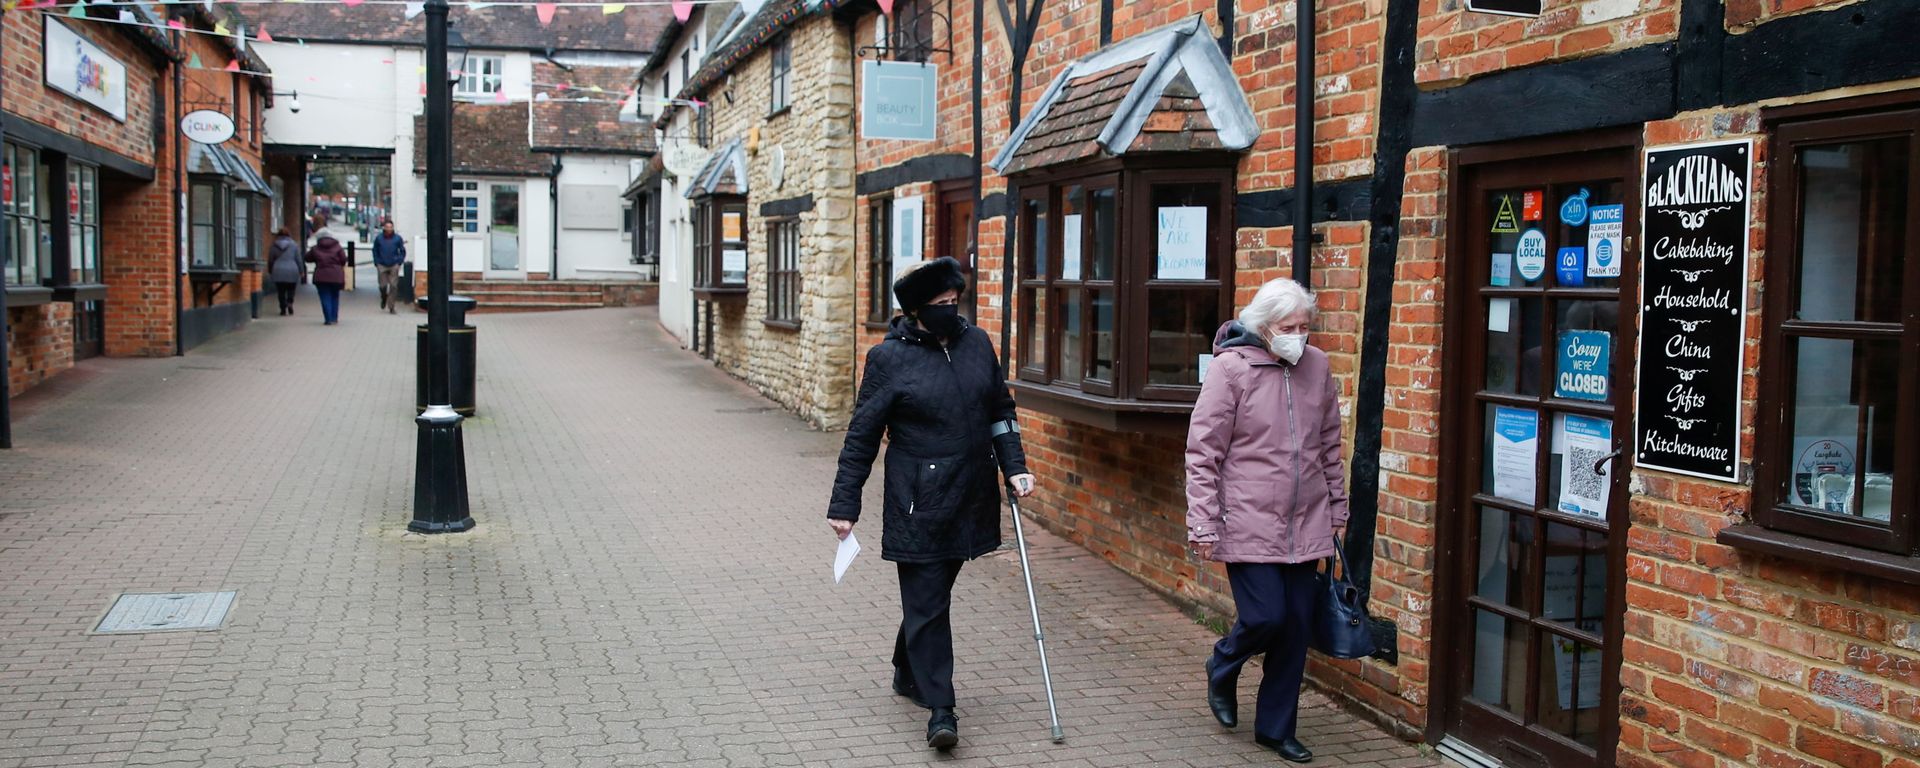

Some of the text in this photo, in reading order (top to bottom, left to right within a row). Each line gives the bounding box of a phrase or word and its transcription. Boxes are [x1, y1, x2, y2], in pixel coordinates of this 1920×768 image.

[876, 103, 916, 114] BEAUTY
[1648, 155, 1744, 208] BLACKHAMS
[1160, 210, 1185, 229] WE
[1592, 208, 1620, 221] NOTICE
[1166, 230, 1192, 245] ARE
[1590, 224, 1606, 232] PLEASE
[1524, 238, 1541, 247] BUY
[1653, 236, 1734, 265] Cakebaking
[1519, 248, 1545, 257] LOCAL
[1588, 267, 1607, 275] THANK
[1608, 266, 1620, 275] YOU
[1653, 285, 1730, 310] Household
[1567, 336, 1601, 366] Sorry
[1665, 334, 1711, 360] China
[1572, 360, 1592, 371] WE'RE
[1560, 371, 1606, 395] CLOSED
[1666, 384, 1706, 413] Gifts
[1644, 428, 1728, 461] Kitchenware
